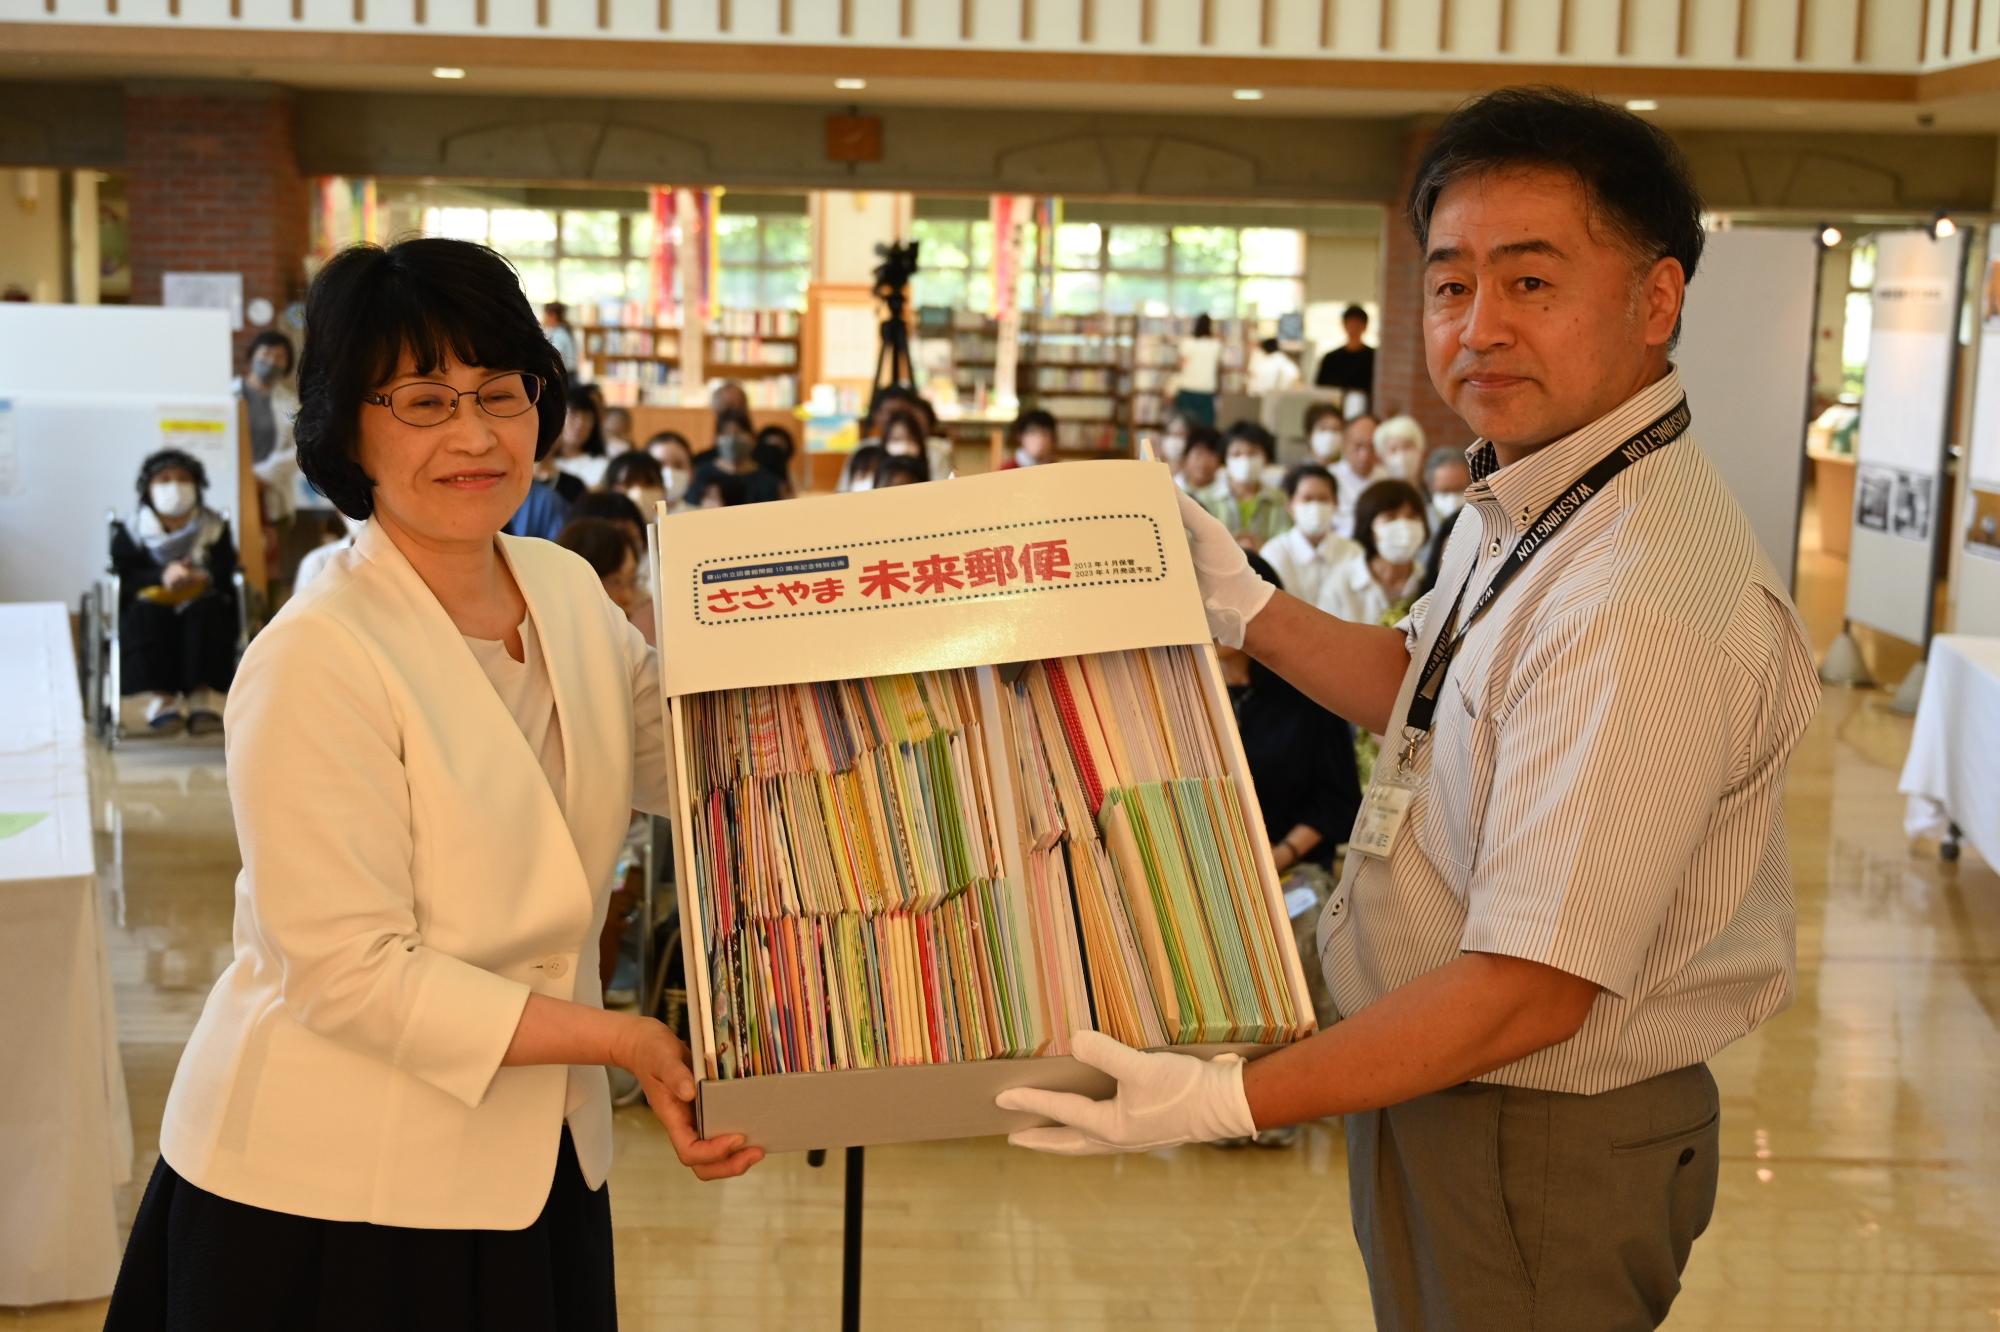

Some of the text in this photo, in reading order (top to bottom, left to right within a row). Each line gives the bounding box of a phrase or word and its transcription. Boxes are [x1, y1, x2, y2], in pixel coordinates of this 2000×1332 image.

[1621, 406, 1689, 462] WASHINGTON
[1516, 482, 1594, 562] WASHINGTON
[707, 539, 1072, 613] ささやま 未来郵便
